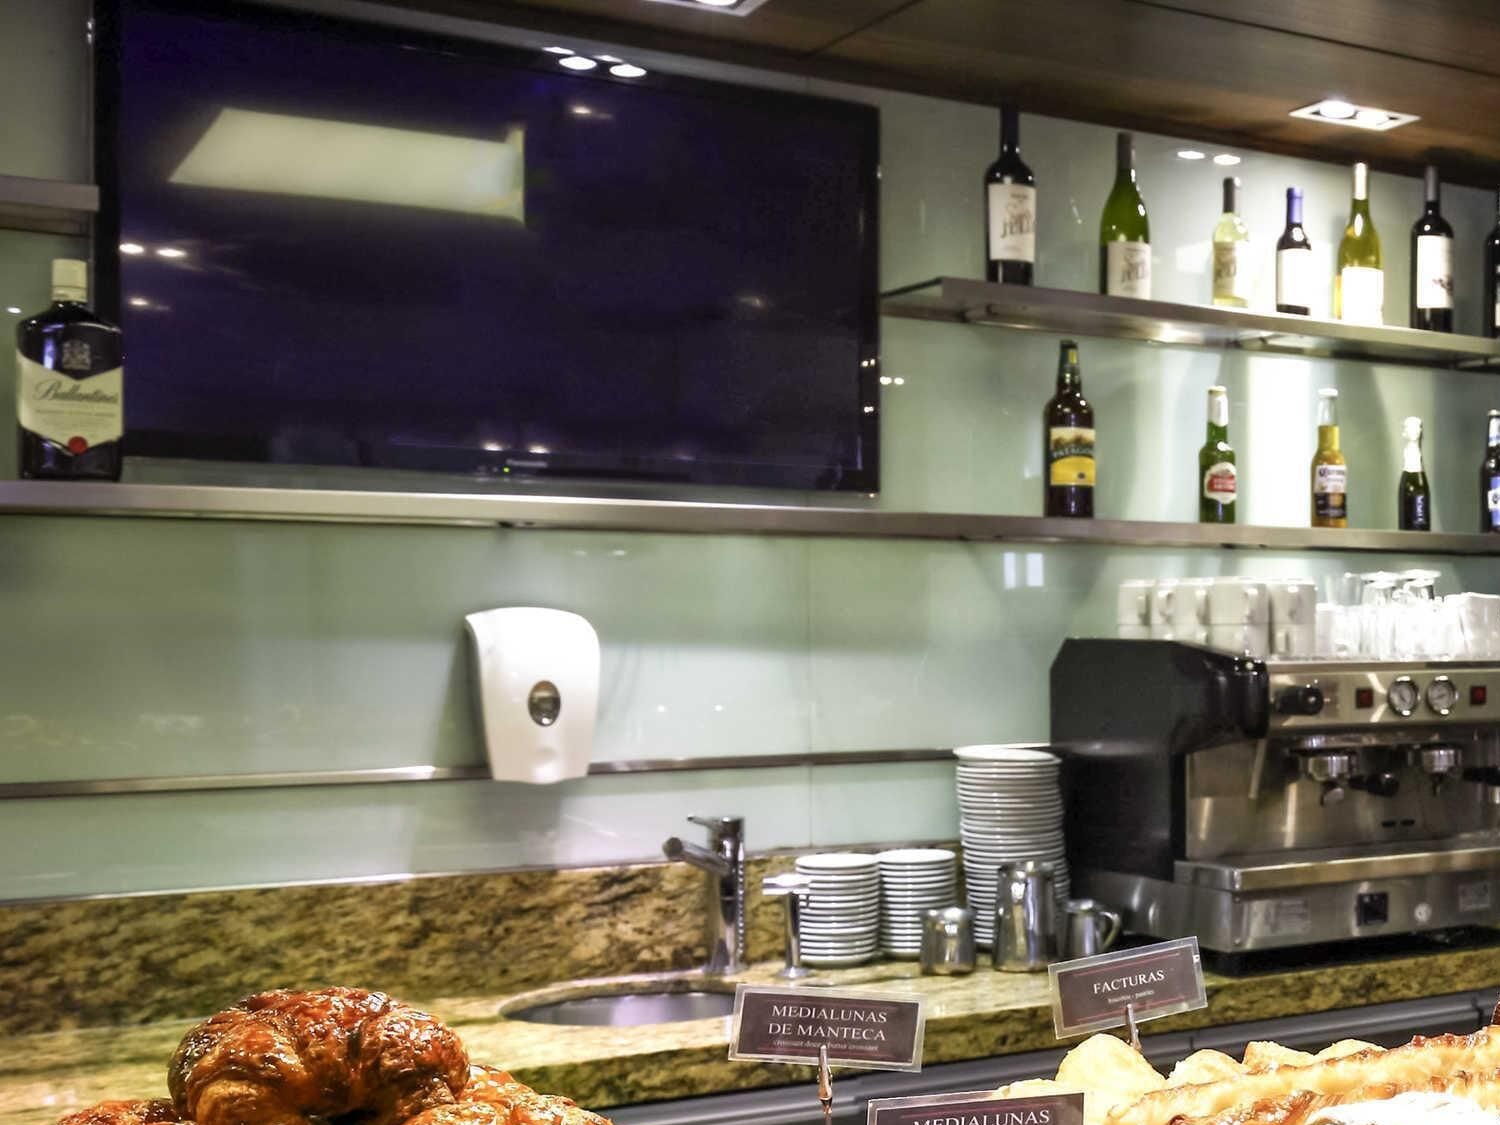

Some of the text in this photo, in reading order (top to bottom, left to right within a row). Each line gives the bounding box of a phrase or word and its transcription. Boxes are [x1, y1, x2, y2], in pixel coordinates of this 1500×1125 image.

[1093, 969, 1166, 995] FACTURAS
[771, 1004, 888, 1024] MEDIALUNAS
[768, 1022, 887, 1042] DE MANTECA
